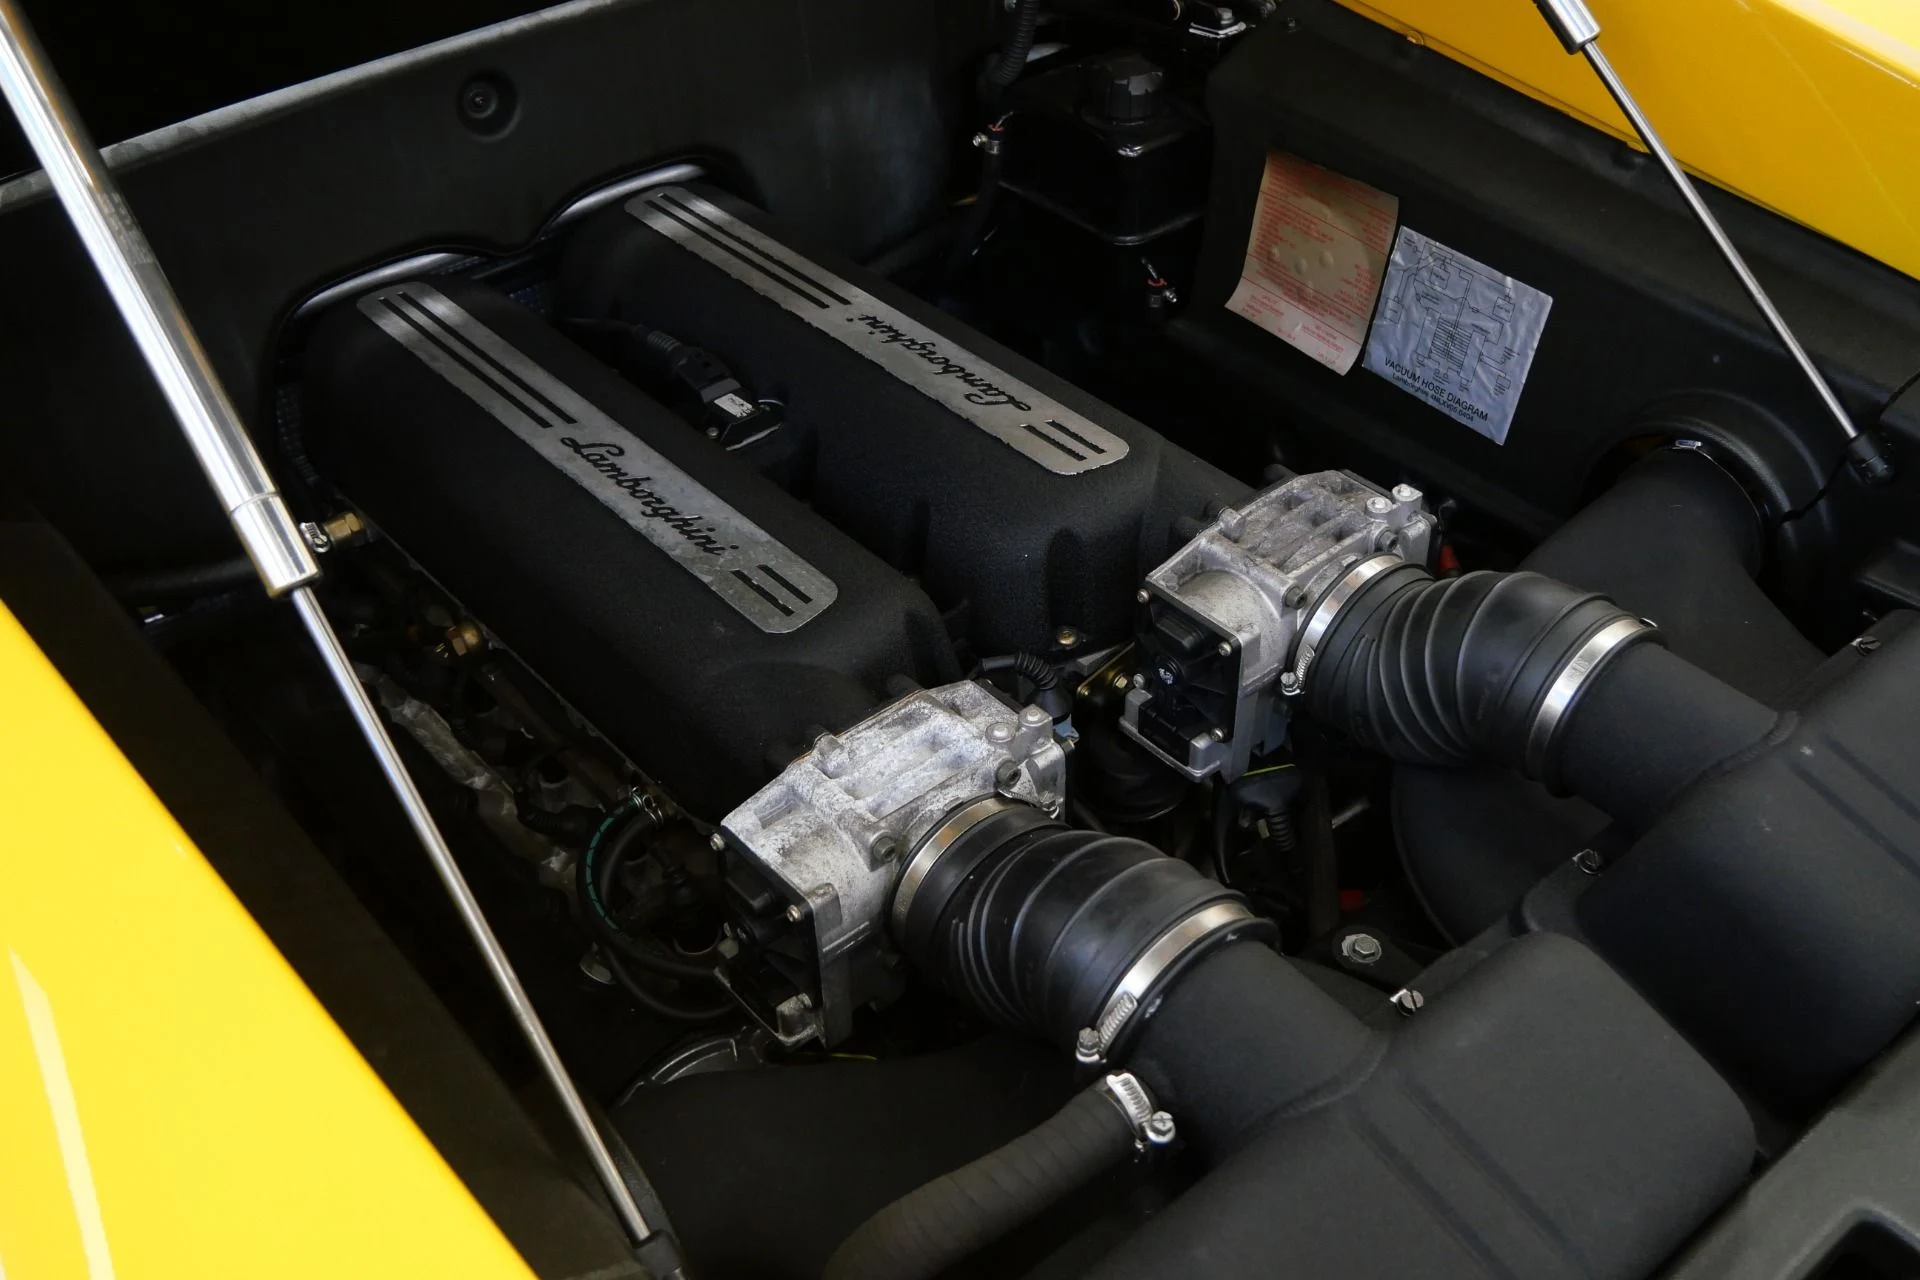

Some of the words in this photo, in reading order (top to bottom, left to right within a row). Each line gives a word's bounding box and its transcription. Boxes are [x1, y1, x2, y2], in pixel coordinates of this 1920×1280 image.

[846, 314, 1032, 412] Lamborghini
[1385, 358, 1420, 383] VACUUM
[1421, 380, 1446, 397] HOSE
[1447, 392, 1488, 421] DIAGRAM
[560, 436, 740, 556] Lamborghini
